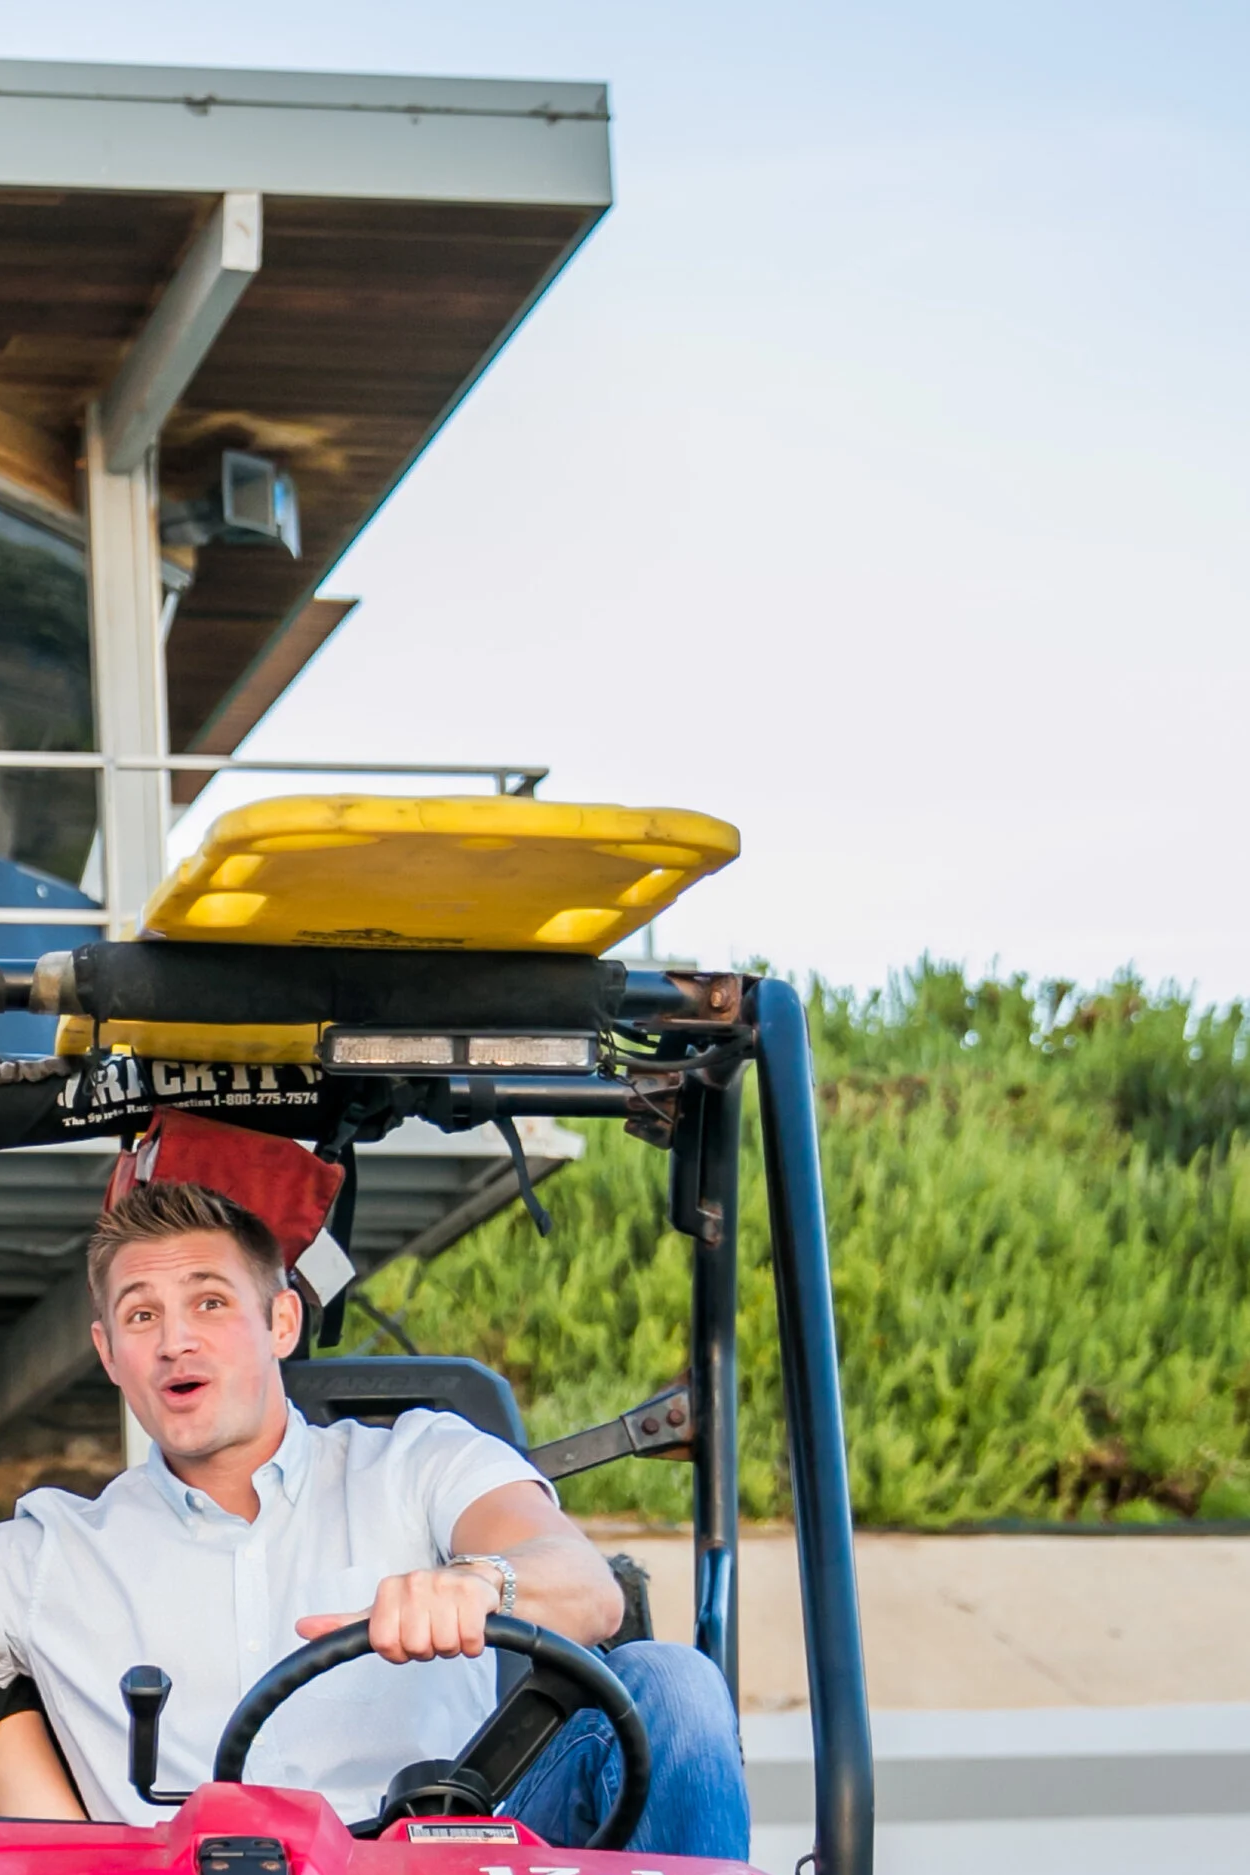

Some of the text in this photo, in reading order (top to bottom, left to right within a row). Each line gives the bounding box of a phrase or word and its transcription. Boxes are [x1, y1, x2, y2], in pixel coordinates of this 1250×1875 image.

[62, 1116, 86, 1127] The
[87, 1108, 125, 1123] Sprts
[214, 1092, 318, 1106] 1-800-275-7574
